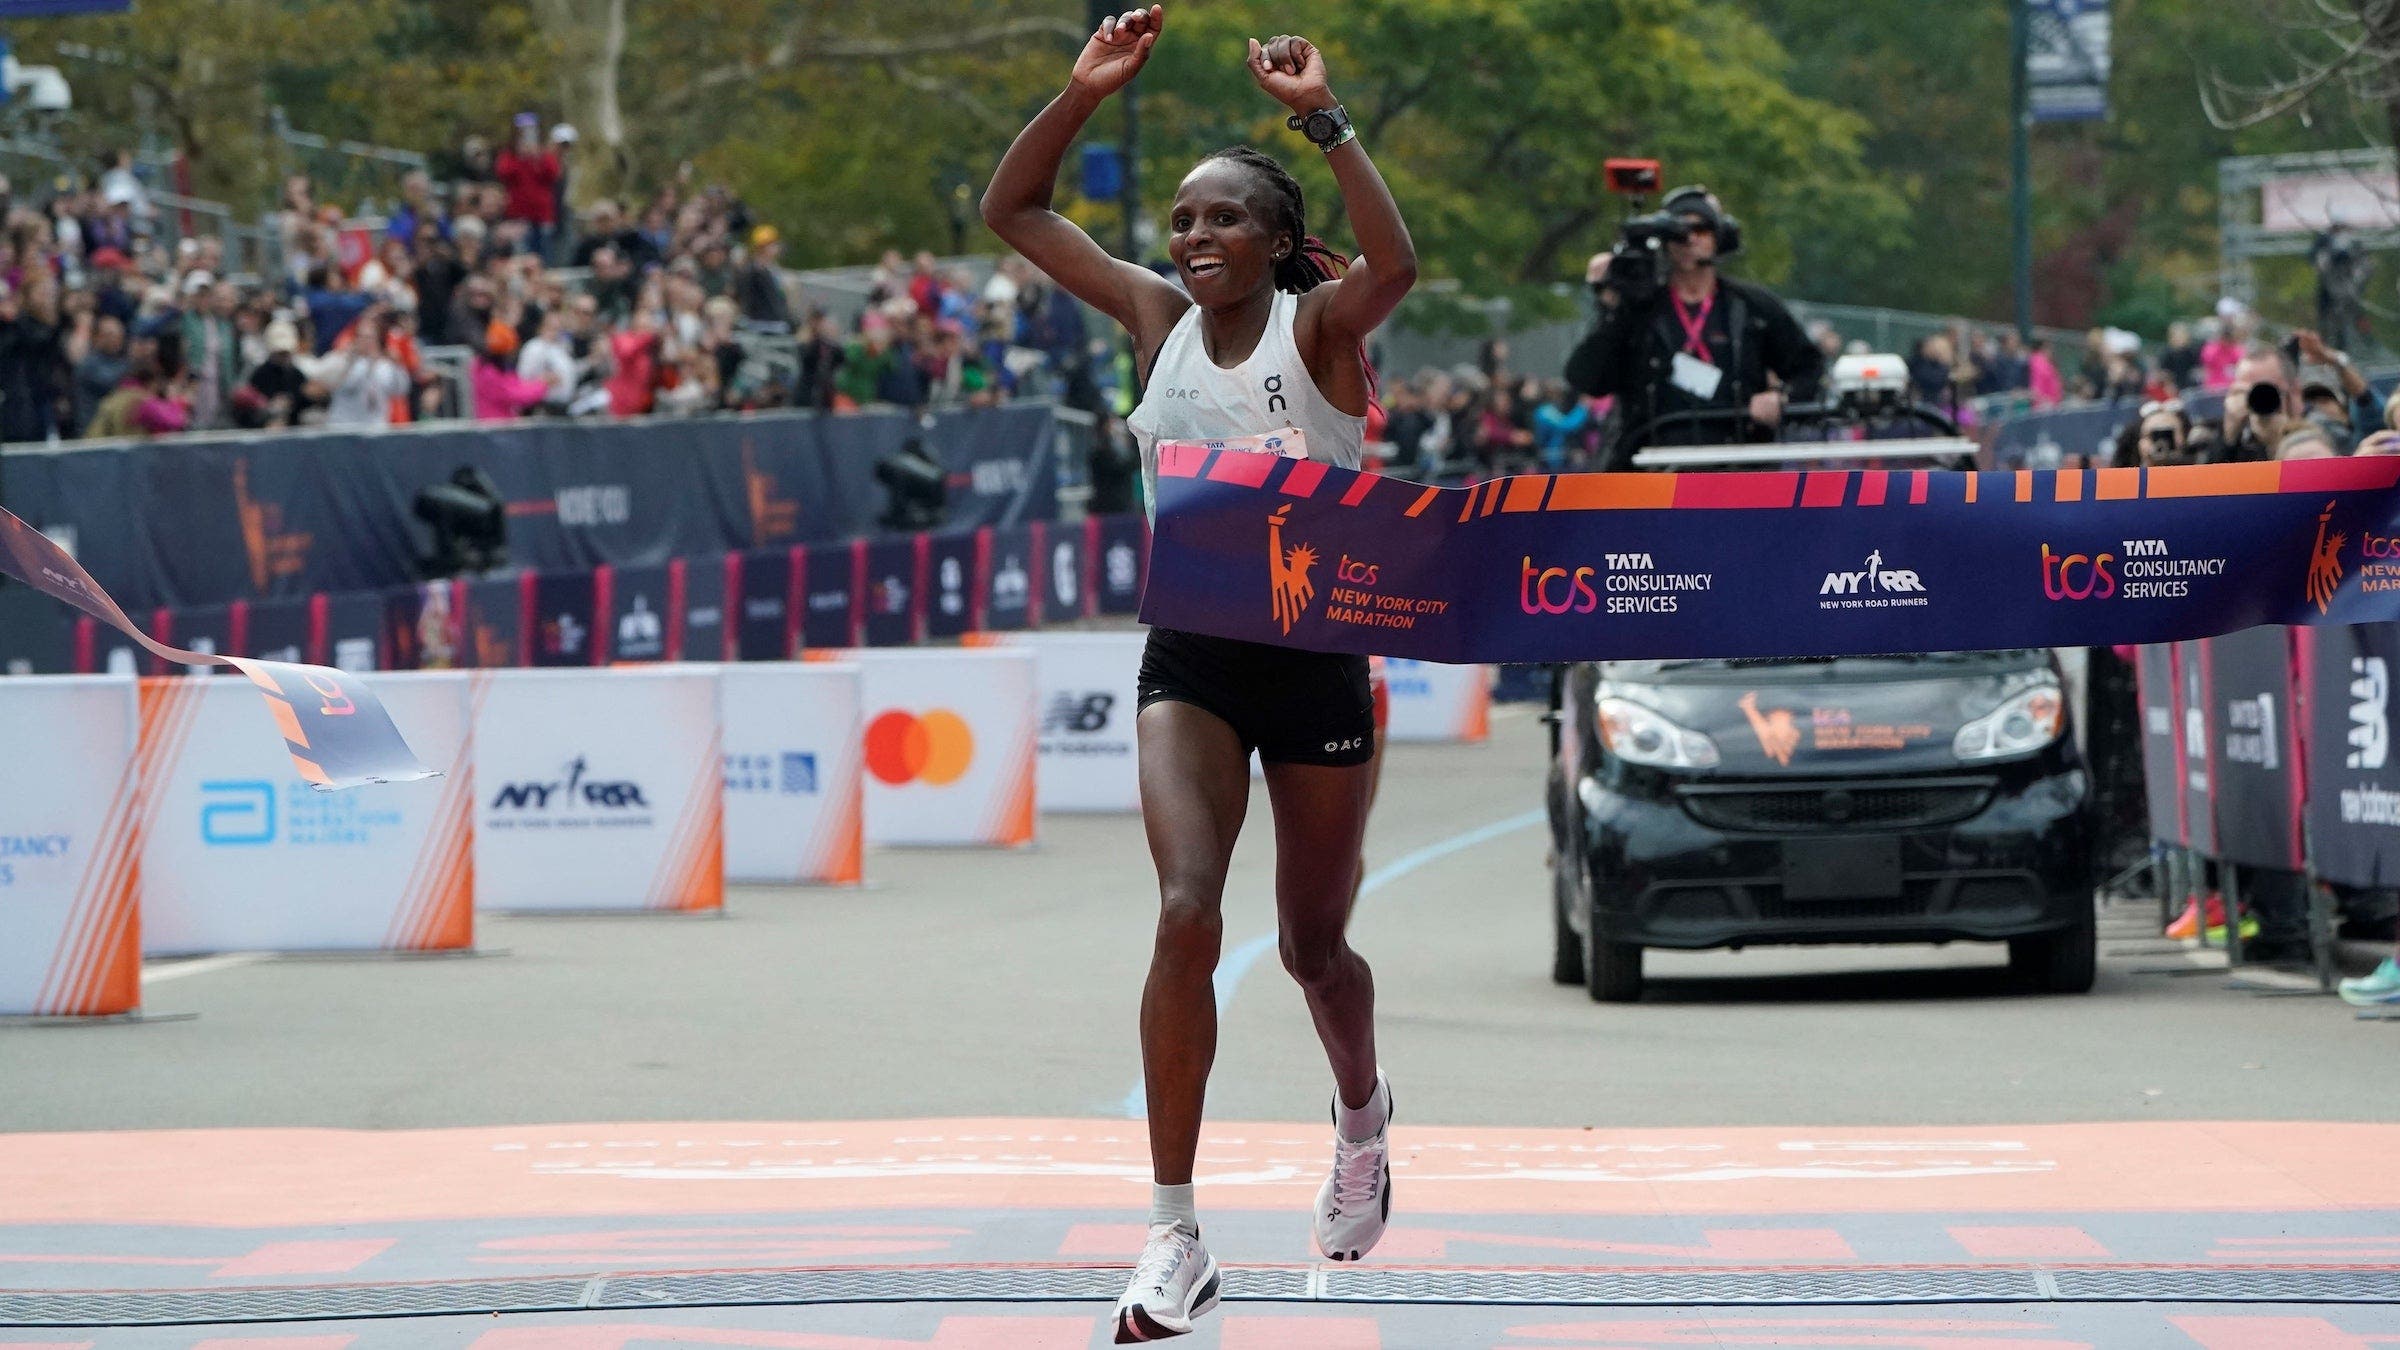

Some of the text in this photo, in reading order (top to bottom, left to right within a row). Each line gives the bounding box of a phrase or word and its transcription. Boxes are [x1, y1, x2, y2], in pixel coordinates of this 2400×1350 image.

[1165, 388, 1200, 399] OAC
[1337, 553, 1380, 586] tcs
[2041, 539, 2169, 600] tcs TATA
[2122, 558, 2227, 578] CONSULTANCY
[1520, 553, 1655, 615] tcs TATA
[1604, 573, 1713, 592] CONSULTANCY
[1819, 569, 1927, 595] NYRR
[2122, 580, 2189, 599] SERVICES
[1331, 587, 1448, 615] NEW YORK CITY
[1606, 596, 1679, 614] SERVICES
[1820, 598, 1929, 610] NEW YORK ROAD RUNNERS
[1326, 605, 1416, 629] MARATHON
[1324, 737, 1362, 752] OAC
